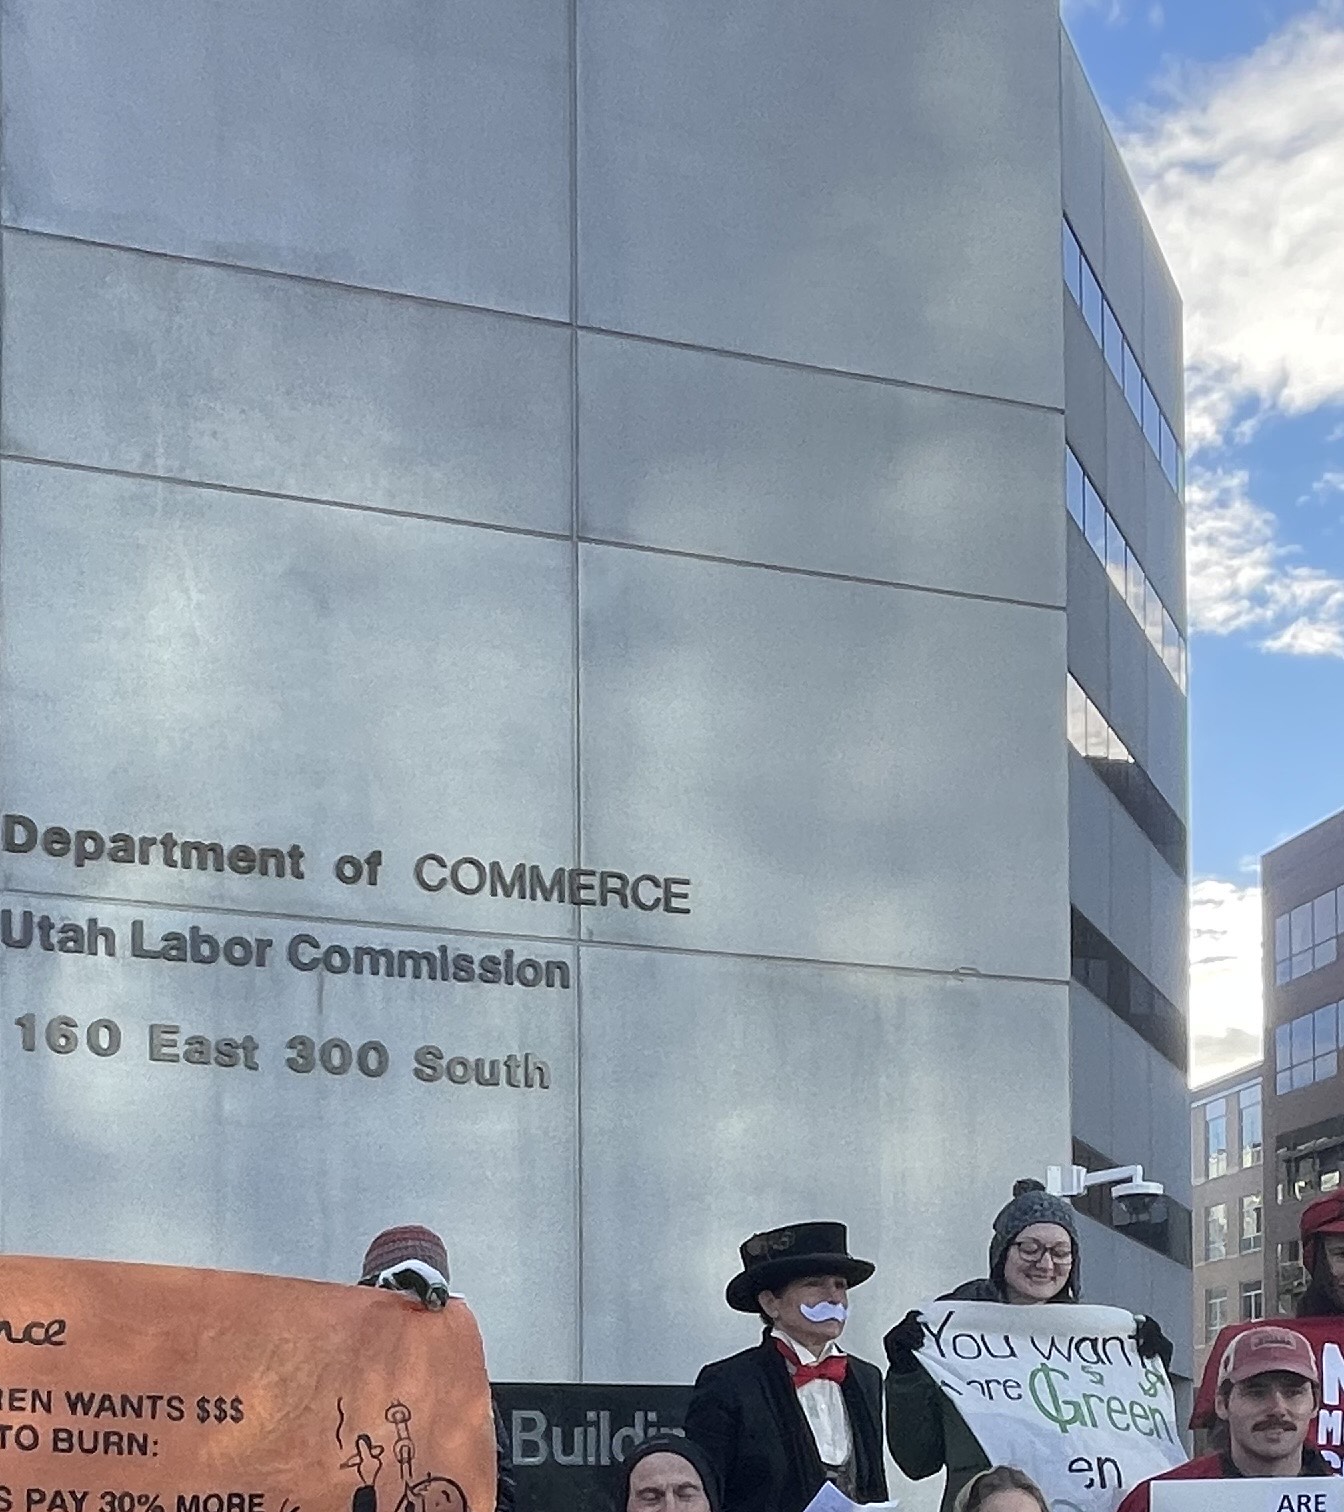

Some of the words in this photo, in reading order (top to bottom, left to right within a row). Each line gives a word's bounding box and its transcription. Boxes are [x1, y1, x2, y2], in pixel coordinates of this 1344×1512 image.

[2, 814, 306, 882] Department
[335, 851, 383, 887] of
[413, 853, 692, 915] COMMERCE
[0, 908, 116, 958] Utah
[131, 920, 273, 971] Labor
[287, 934, 572, 991] Commission
[14, 1013, 122, 1058] 160
[148, 1024, 259, 1072] East
[285, 1036, 390, 1079] 300
[413, 1045, 551, 1092] South
[922, 1311, 1019, 1360] You
[63, 1390, 185, 1422] WANTS
[195, 1394, 244, 1424] $$$
[52, 1427, 159, 1458] BURN:
[511, 1409, 686, 1466] Build
